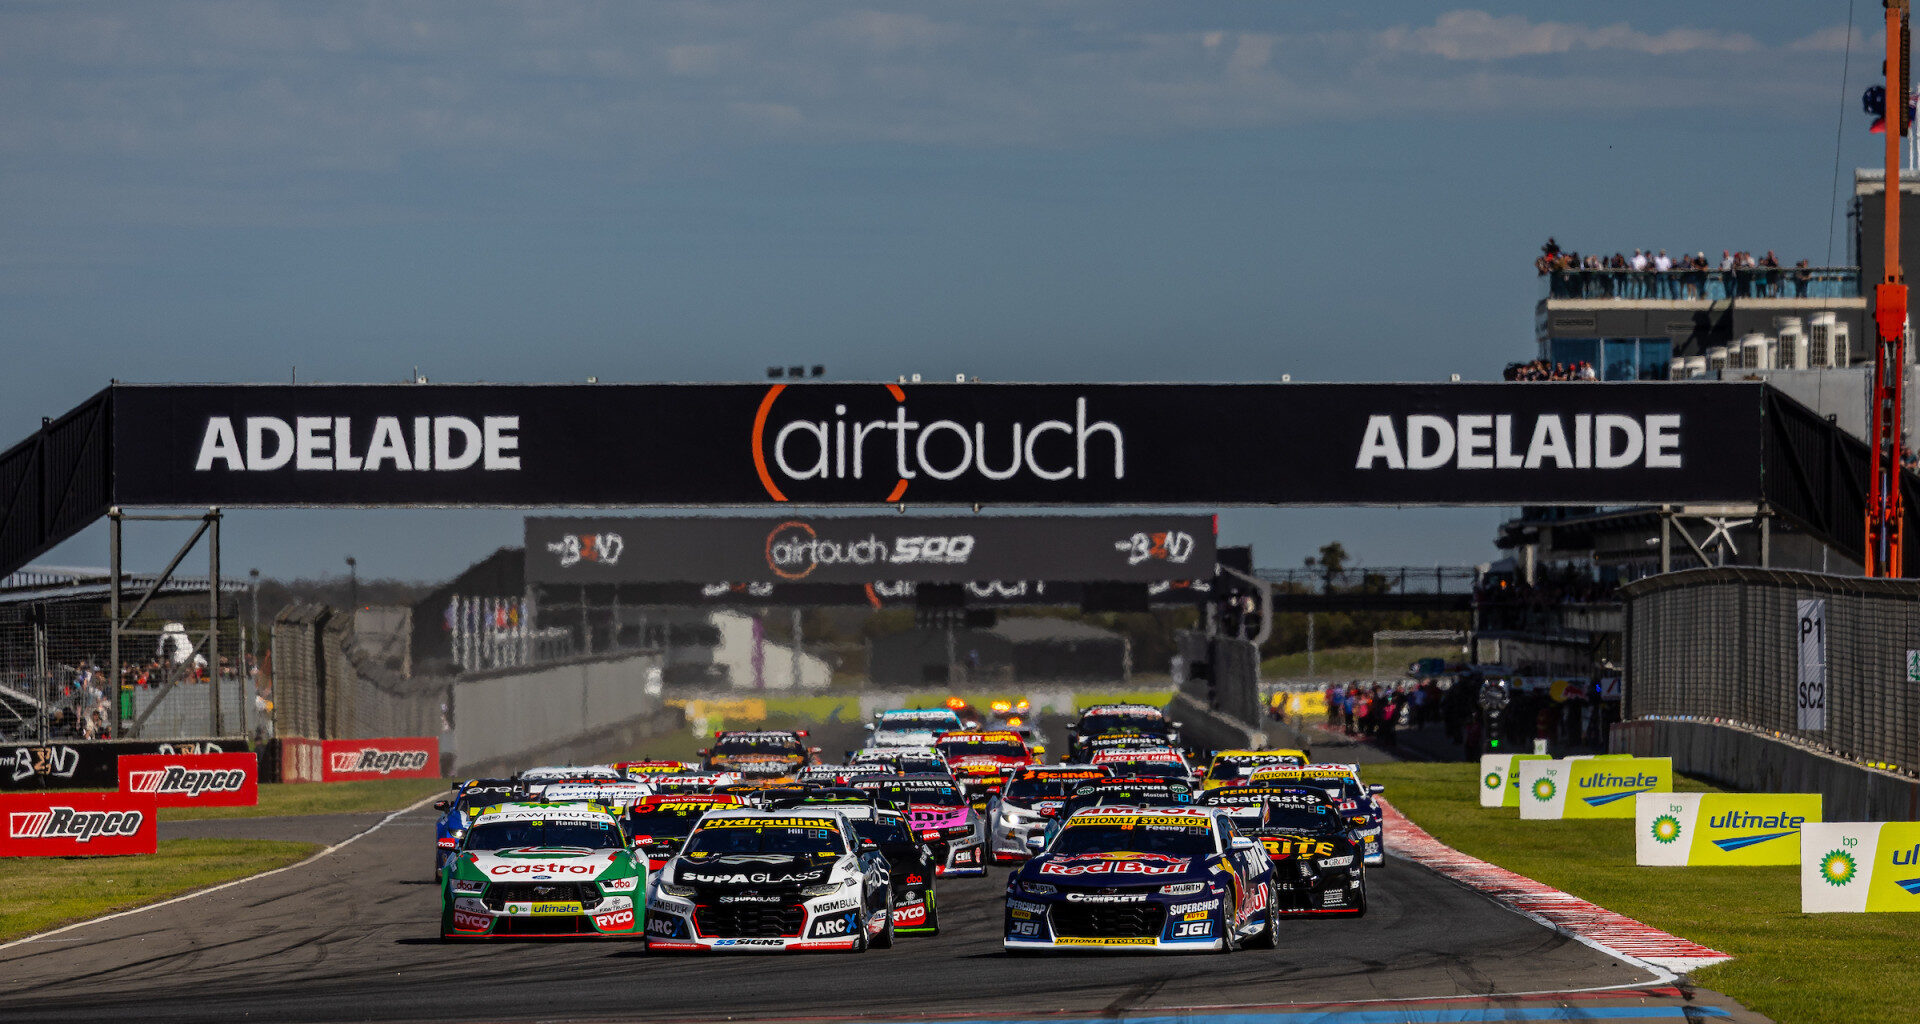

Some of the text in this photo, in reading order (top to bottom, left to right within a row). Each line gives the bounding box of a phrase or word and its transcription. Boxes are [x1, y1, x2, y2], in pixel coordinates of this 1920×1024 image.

[195, 415, 521, 470] ADELAIDE
[775, 397, 1123, 480] airtouch
[1356, 414, 1681, 469] ADELAIDE
[772, 535, 975, 564] airtouch 500
[1801, 617, 1822, 645] P1
[1798, 682, 1824, 708] SC2
[358, 749, 429, 774] Repco
[1546, 768, 1557, 777] bp
[1579, 772, 1658, 788] ultimate
[157, 766, 246, 798] Repco
[657, 803, 745, 812] PIRTEK
[1207, 795, 1300, 806] Steadfast
[1669, 802, 1683, 814] bp
[46, 807, 142, 843] Repco
[555, 819, 588, 827] Randle
[705, 817, 834, 828] Hydraulink
[1070, 816, 1206, 826] NATIONAL STORAGE
[1710, 811, 1805, 829] ultimate
[787, 827, 804, 835] Hill
[1145, 825, 1187, 833] Feeney
[1262, 841, 1334, 857] RITE
[1842, 836, 1858, 849] bp
[490, 863, 596, 876] Castrol
[518, 904, 528, 913] bp
[534, 902, 580, 914] ultimate
[893, 906, 925, 921] RYCO
[1013, 910, 1030, 919] AUTO
[1169, 898, 1220, 916] SUPERCHEAP
[454, 911, 492, 929] RYCO
[595, 912, 632, 928] RYCO
[1186, 912, 1206, 920] AUTO
[1010, 922, 1041, 936] JGI
[1174, 922, 1212, 937] JGI
